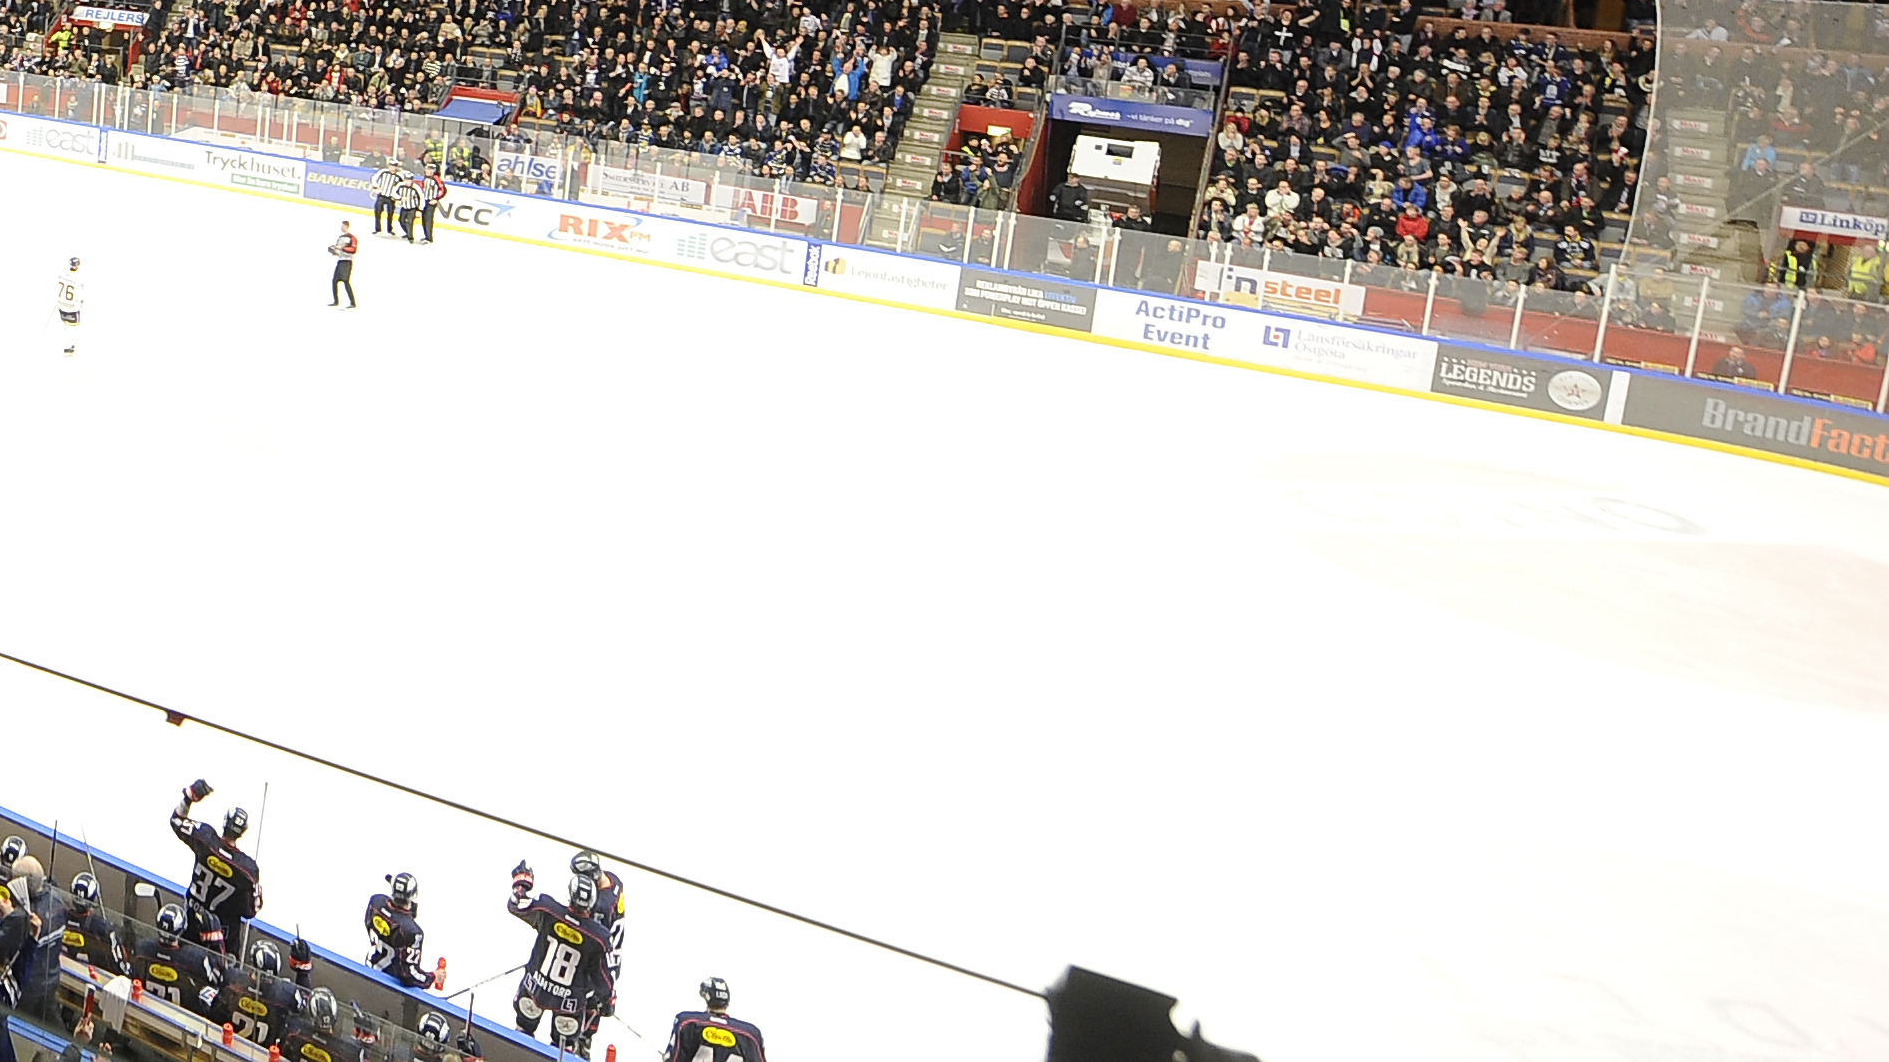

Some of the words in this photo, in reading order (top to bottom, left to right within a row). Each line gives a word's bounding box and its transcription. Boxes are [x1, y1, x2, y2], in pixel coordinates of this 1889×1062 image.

[85, 8, 144, 24] REJLERS
[45, 129, 95, 155] east
[669, 179, 690, 193] AB
[437, 202, 493, 226] NCC
[735, 188, 800, 221] ABB
[559, 213, 632, 244] RIX
[629, 230, 652, 242] FM
[710, 236, 794, 274] east
[805, 245, 821, 285] Reebok
[58, 281, 75, 301] 76
[851, 266, 949, 291] Lejonfastigheter
[1135, 299, 1227, 330] ActiPro
[1143, 323, 1212, 351] Event
[1294, 340, 1346, 361] Östgöta
[1296, 329, 1419, 361] Länsförsäkringar
[1440, 362, 1537, 392] LEGENDS
[1701, 397, 1889, 464] BrandFact
[190, 863, 236, 911] 37
[540, 934, 581, 987] 18
[230, 1010, 269, 1045] 21
